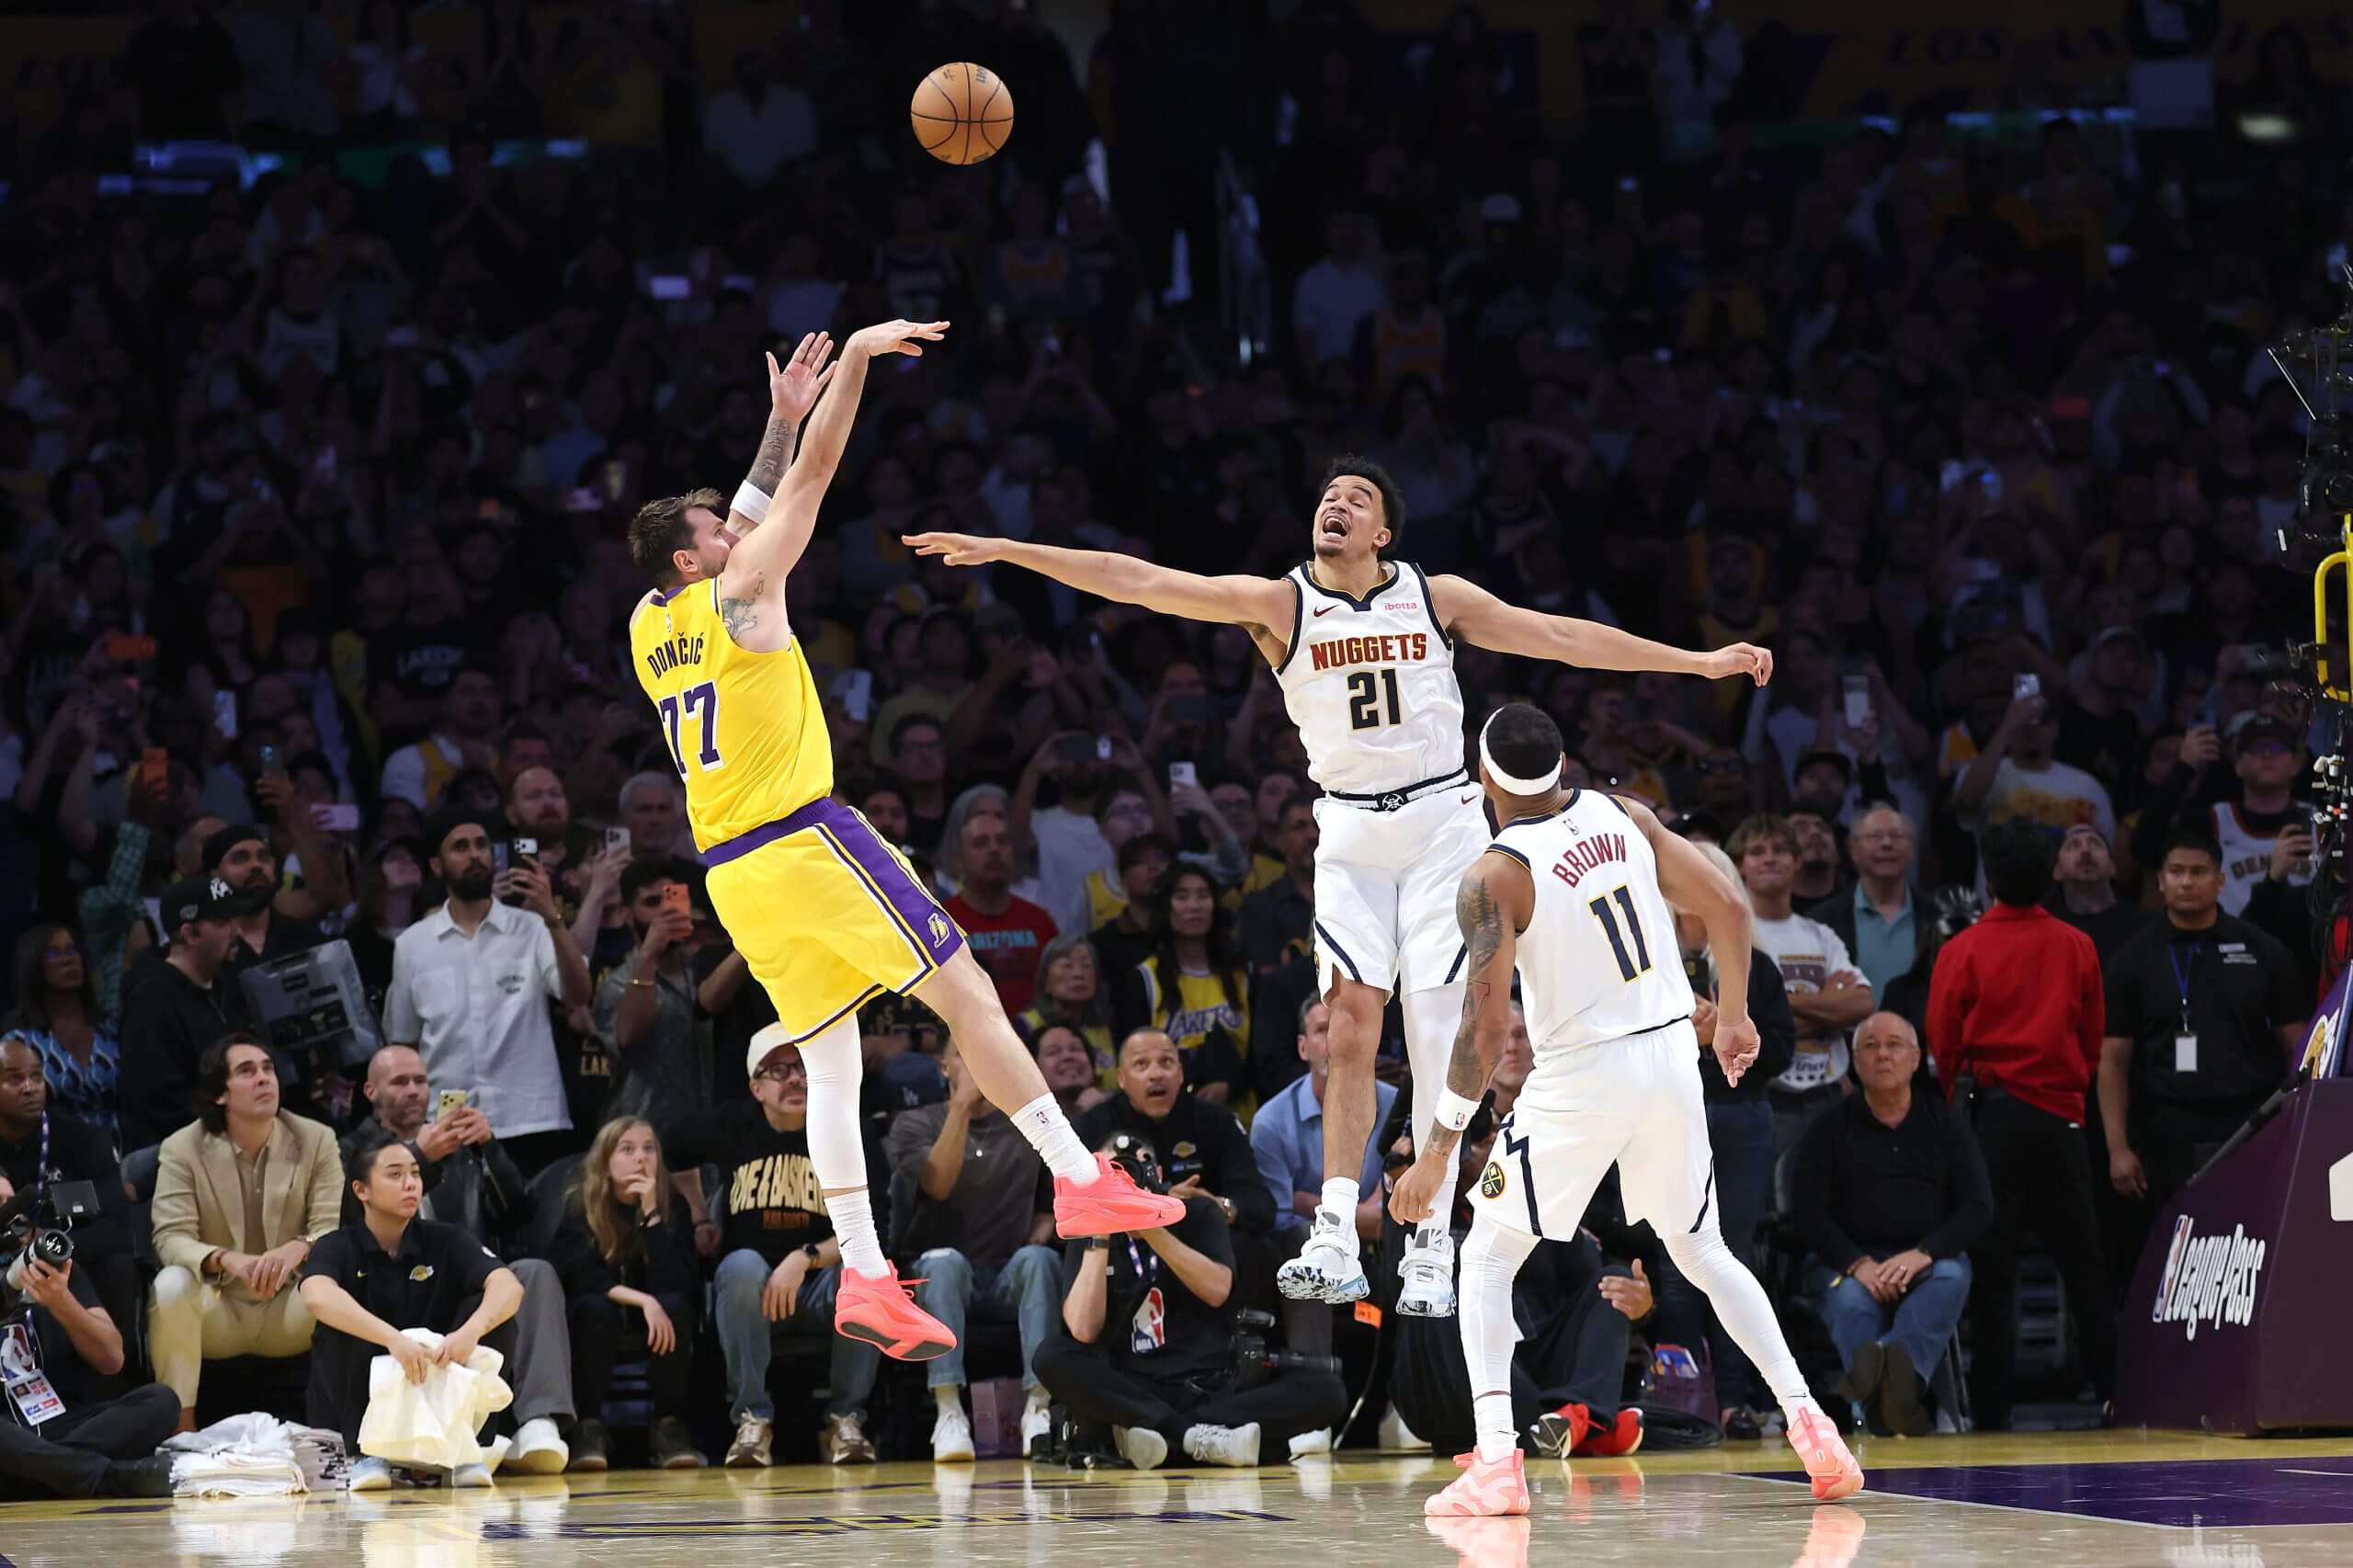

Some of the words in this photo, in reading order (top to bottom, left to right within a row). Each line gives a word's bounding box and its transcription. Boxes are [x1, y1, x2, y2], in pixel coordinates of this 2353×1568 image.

[1384, 602, 1417, 611] ibotta
[647, 631, 705, 679] DONČIĆ
[1310, 632, 1427, 671] NUGGETS
[1347, 668, 1402, 730] 21
[658, 680, 722, 775] 77
[1552, 833, 1627, 889] BROWN
[1588, 884, 1652, 983] 11
